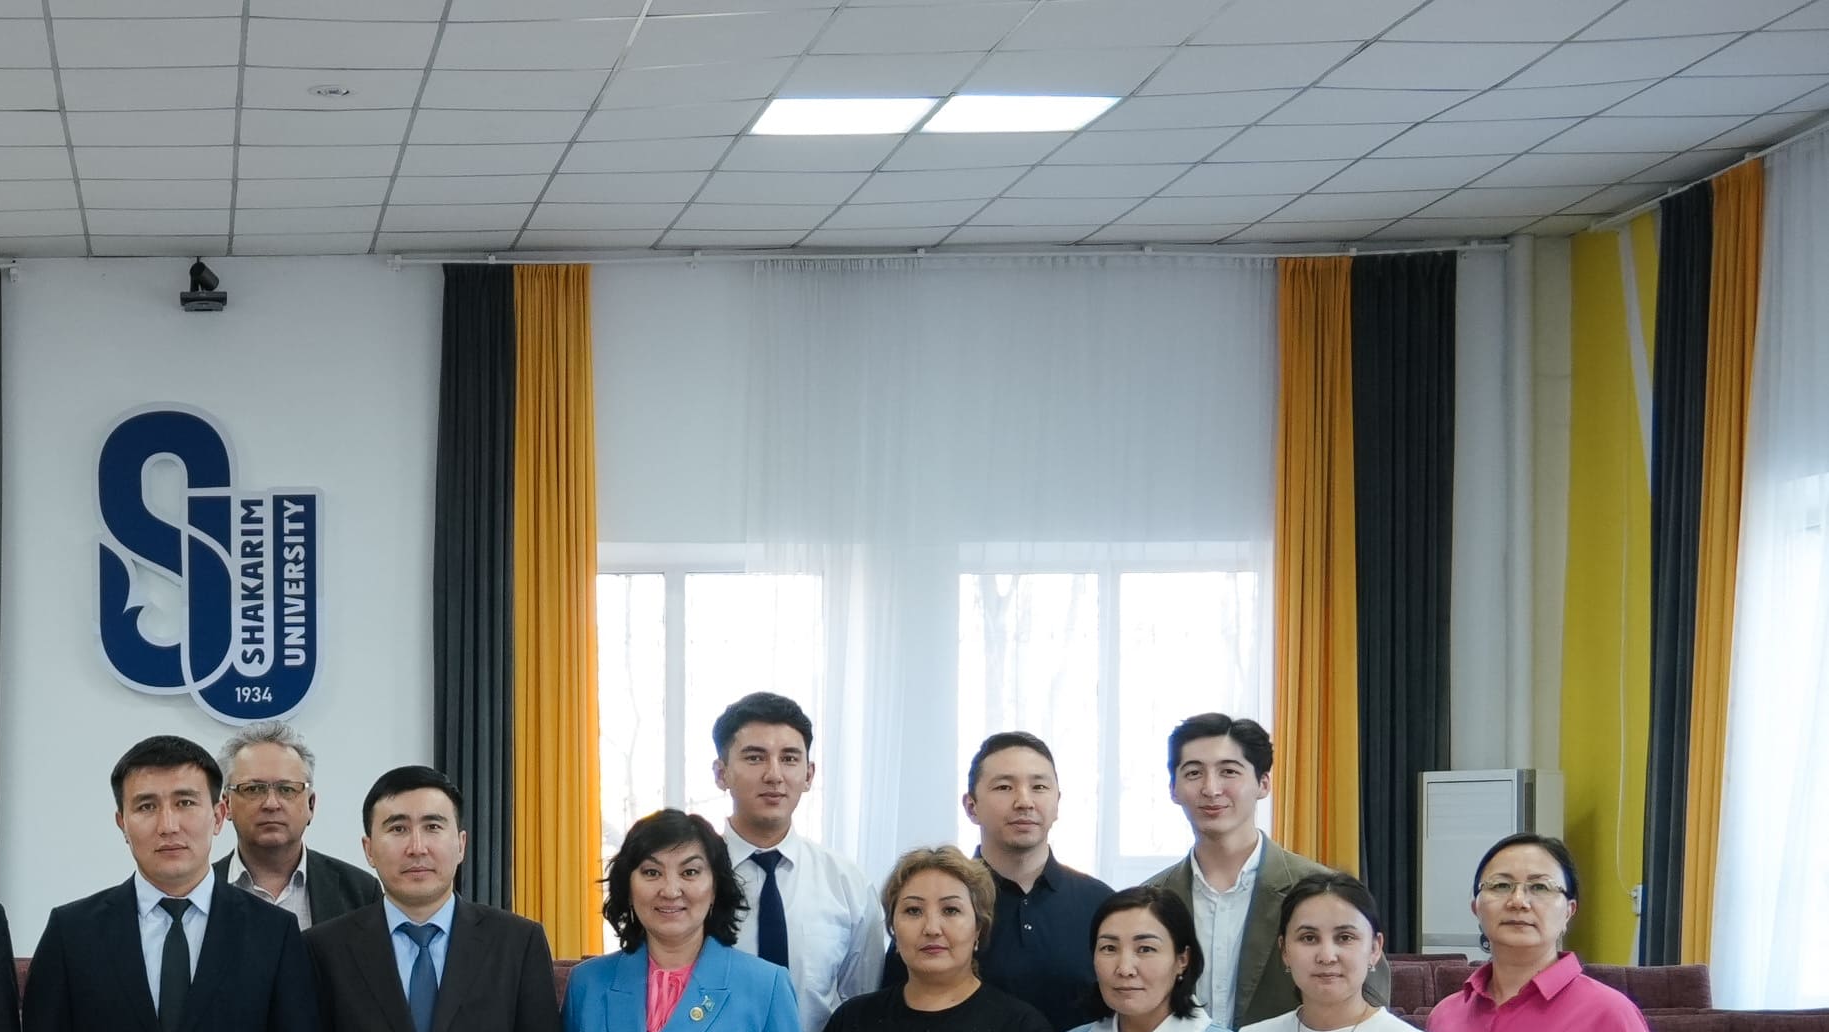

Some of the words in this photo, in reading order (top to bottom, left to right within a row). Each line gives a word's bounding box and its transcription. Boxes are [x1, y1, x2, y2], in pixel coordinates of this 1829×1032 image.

[240, 498, 264, 665] SHAKARIM
[283, 499, 306, 667] UNIVERSITY
[234, 686, 273, 703] 1934
